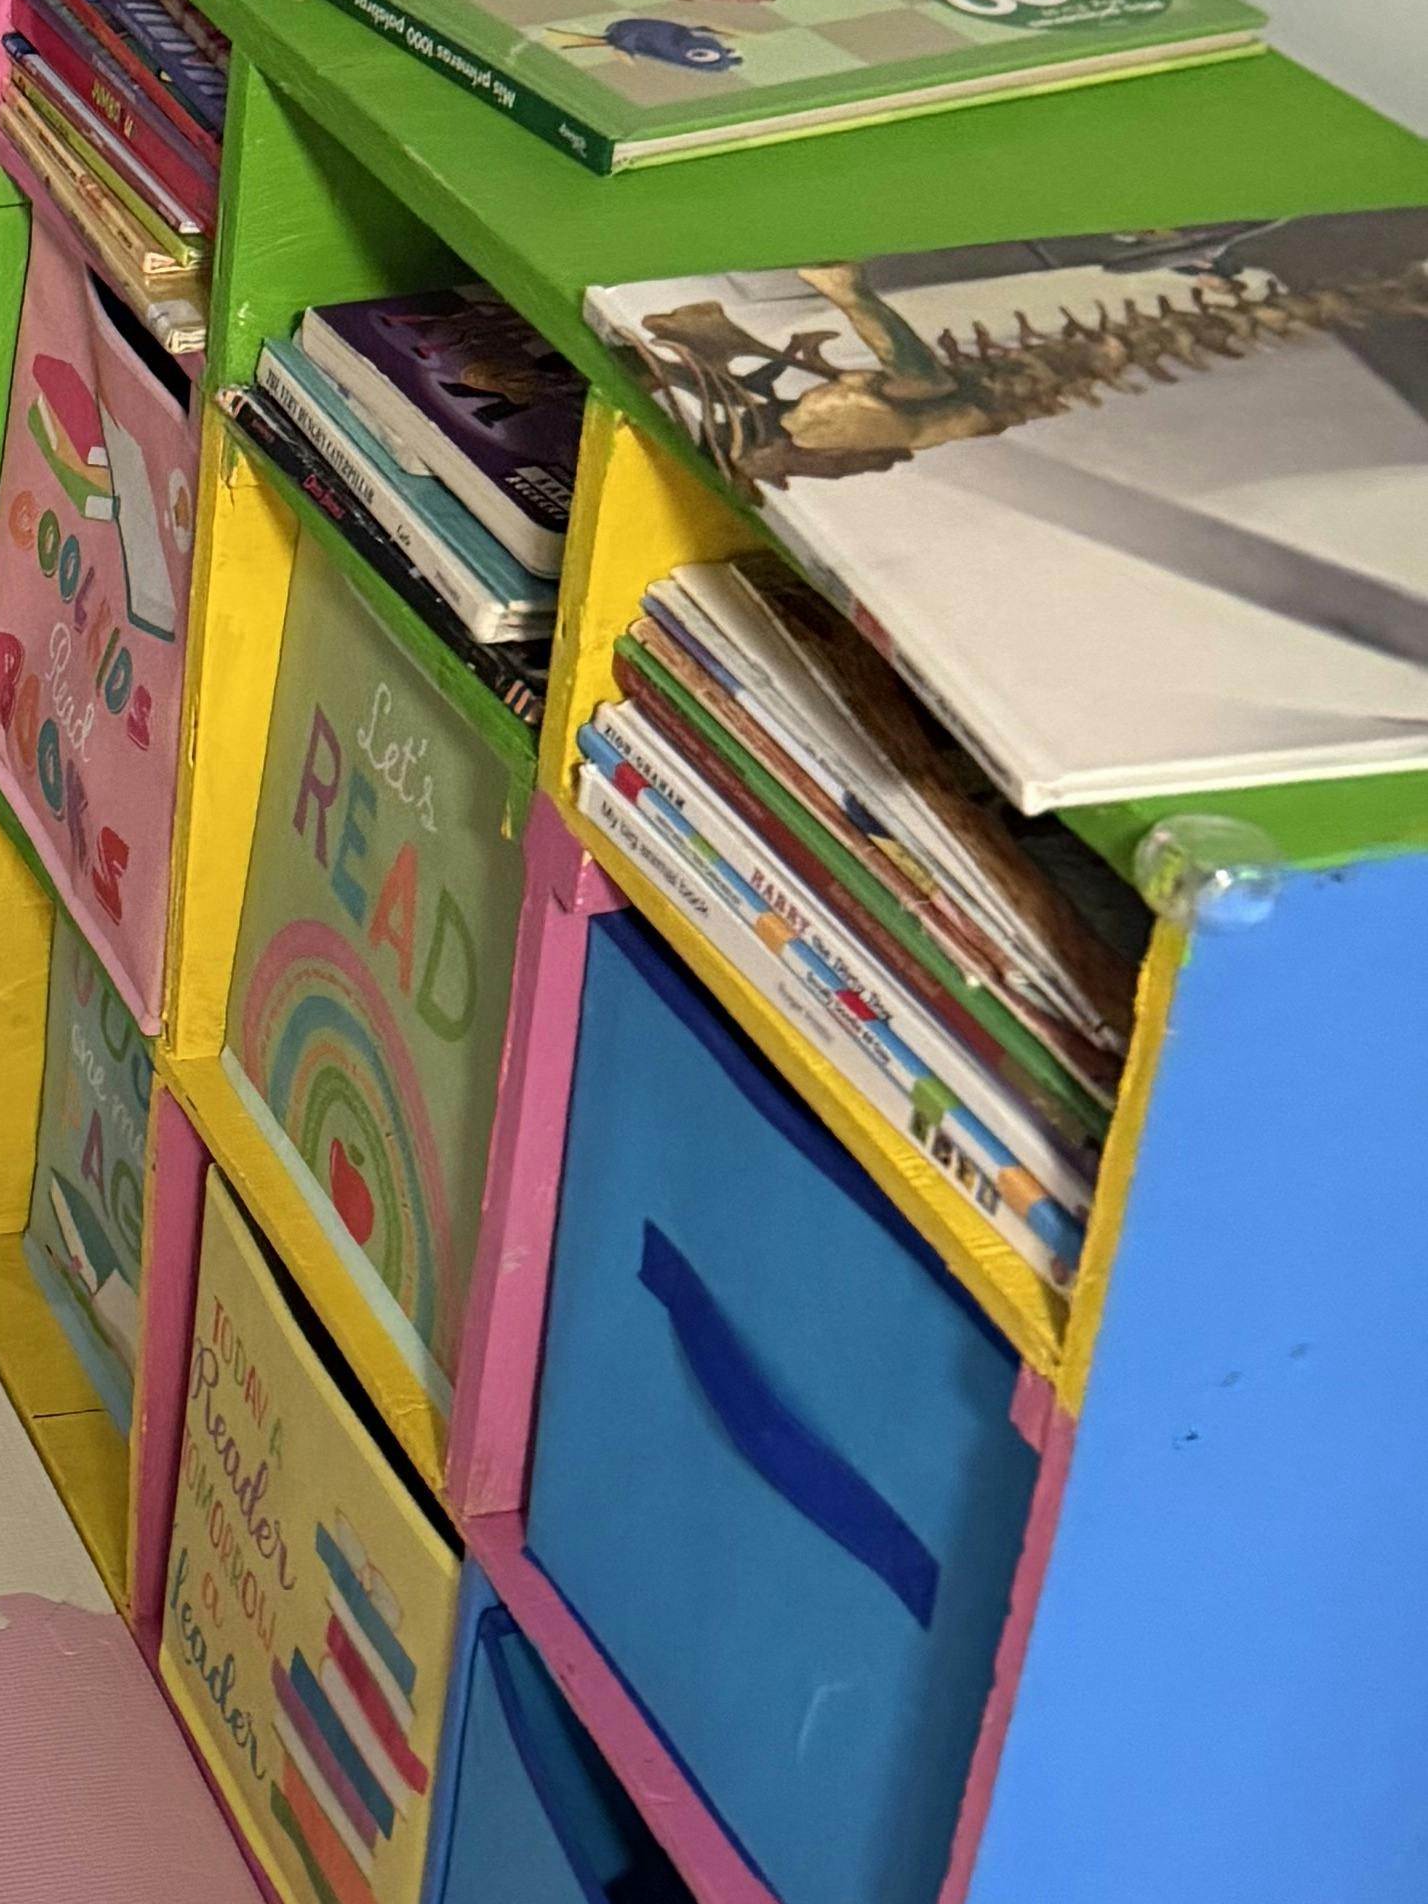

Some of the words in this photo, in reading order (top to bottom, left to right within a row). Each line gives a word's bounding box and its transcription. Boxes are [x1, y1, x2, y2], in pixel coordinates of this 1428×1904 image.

[405, 24, 434, 58] 1000
[435, 44, 492, 92] primeras
[492, 79, 517, 109] Mis
[8, 489, 95, 634] COOL
[84, 596, 153, 752] KIDS
[45, 622, 95, 764] Read
[356, 680, 438, 834] Let's
[291, 701, 478, 1043] READ
[601, 799, 618, 830] My
[619, 820, 640, 850] big
[640, 844, 679, 886] animal
[749, 866, 812, 933] HARRY
[211, 1294, 269, 1430] TODAY
[268, 1417, 284, 1471] A
[189, 1336, 298, 1591] Reader
[182, 1423, 277, 1654] TOMORROW
